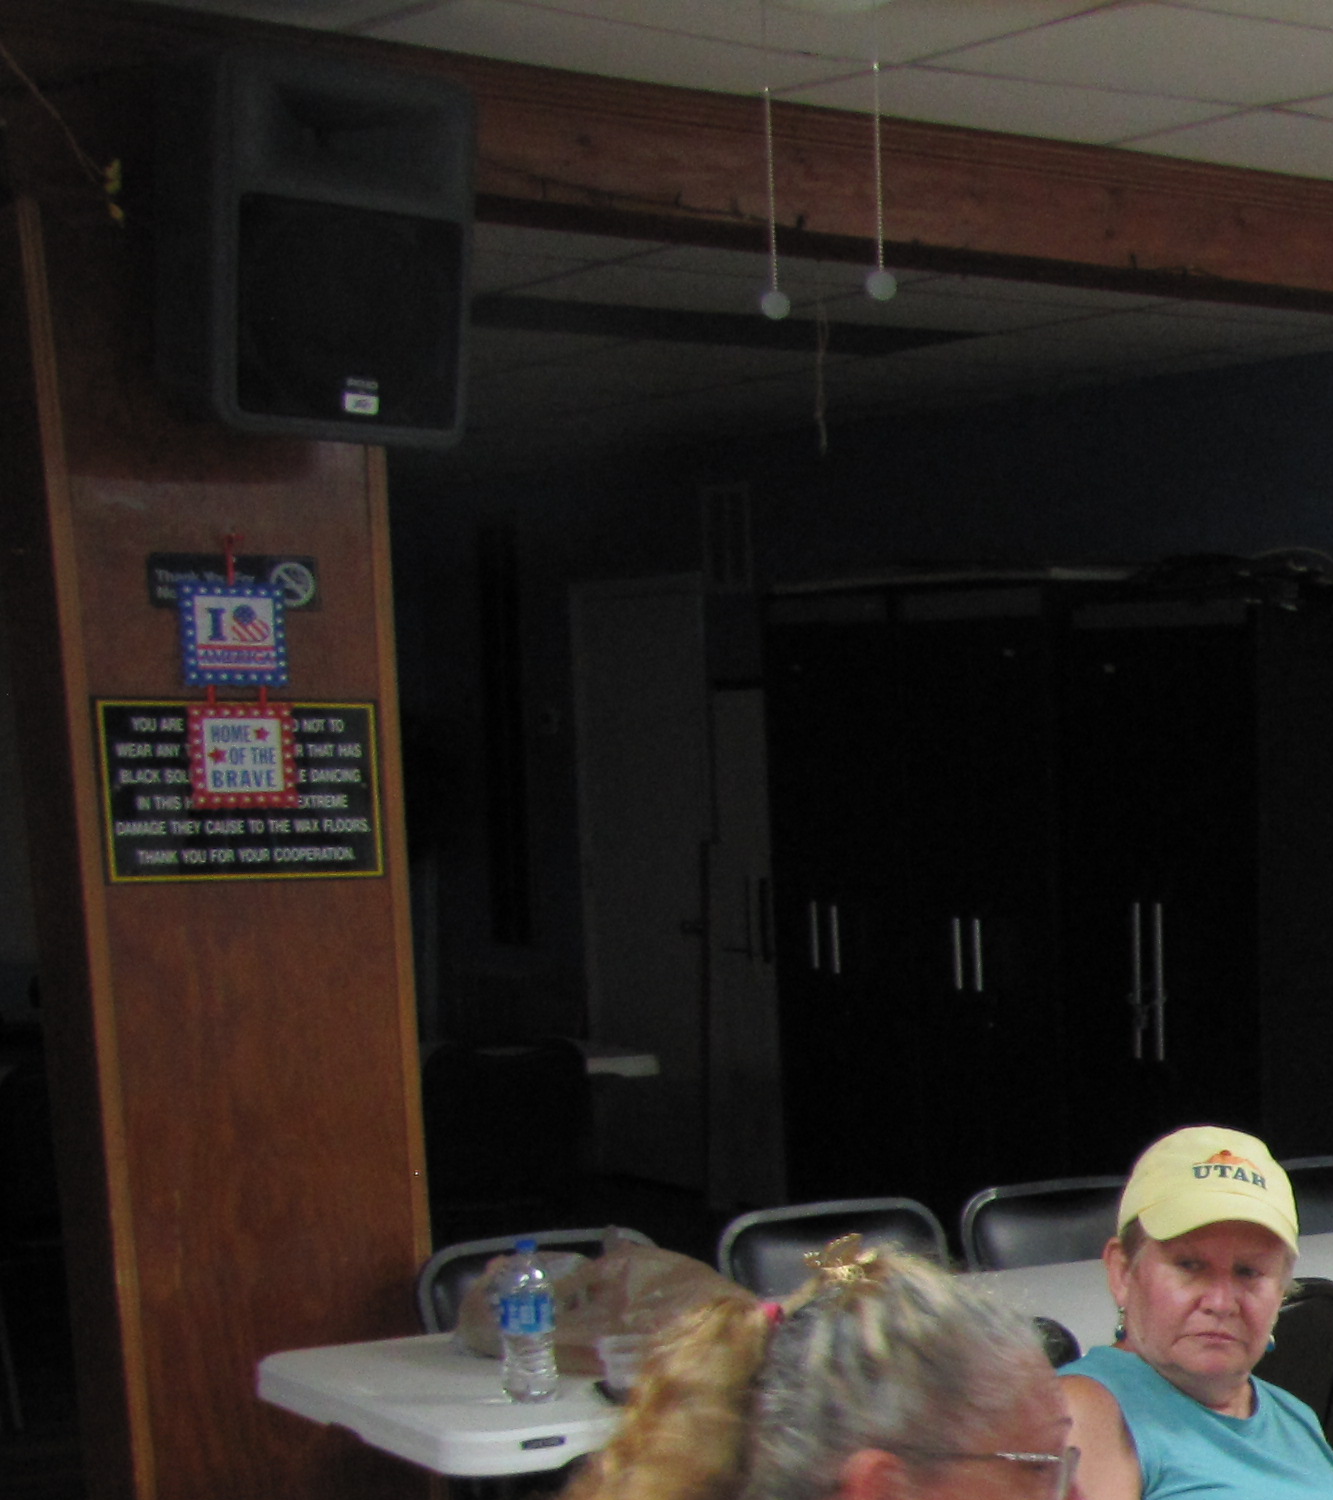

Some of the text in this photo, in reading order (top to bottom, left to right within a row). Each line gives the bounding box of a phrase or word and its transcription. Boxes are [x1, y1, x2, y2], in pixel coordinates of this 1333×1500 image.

[206, 607, 227, 642] I
[131, 717, 157, 732] YOU
[160, 717, 184, 732] ARE
[302, 718, 326, 733] NOT
[329, 718, 345, 733] TO
[211, 724, 252, 744] HOME
[115, 743, 153, 758] WEAR
[155, 743, 181, 758] ANY
[307, 743, 336, 758] THAT
[338, 742, 363, 758] HAS
[228, 746, 247, 766] OF
[251, 746, 277, 766] THE
[119, 768, 162, 784] BLACK
[310, 768, 362, 784] DANCING
[211, 769, 277, 788] BRAVE
[136, 796, 151, 811] IN
[153, 796, 182, 811] THIS
[115, 820, 167, 836] DAMAGE
[170, 820, 201, 836] THEY
[204, 819, 245, 835] CAUSE
[248, 819, 265, 834] TO
[267, 818, 292, 834] THE
[294, 817, 320, 833] WAX
[137, 849, 179, 866] THANK
[182, 849, 207, 866] YOU
[209, 848, 236, 865] FOR
[238, 847, 270, 864] YOUR
[1192, 1165, 1268, 1191] UTAH
